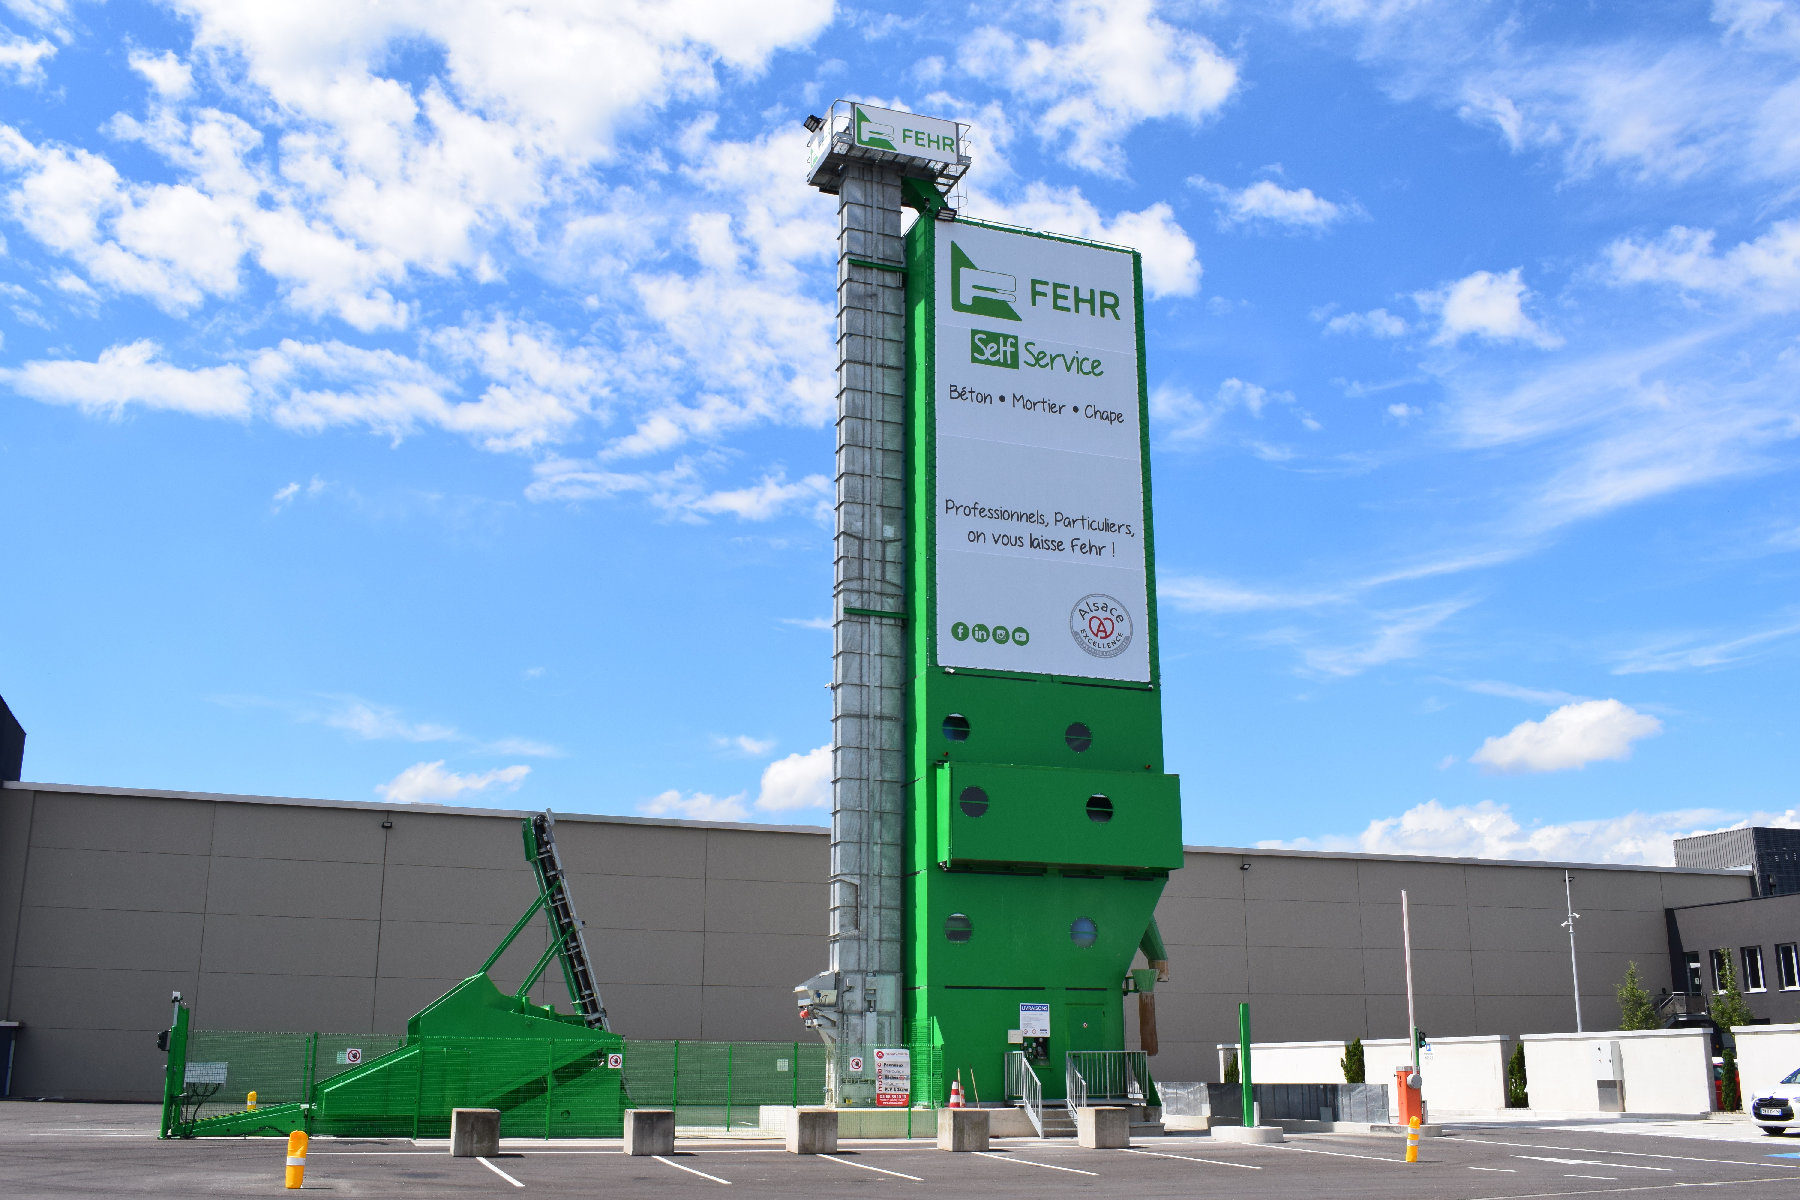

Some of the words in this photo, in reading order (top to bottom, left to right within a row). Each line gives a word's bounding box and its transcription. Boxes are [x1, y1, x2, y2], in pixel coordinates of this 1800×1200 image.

[902, 128, 955, 153] FEHR
[1030, 278, 1121, 321] FEHR
[973, 333, 1016, 365] Self
[1023, 341, 1104, 377] Service
[949, 383, 993, 405] Béton
[1012, 392, 1066, 415] Mortier
[1084, 404, 1125, 425] Chape
[945, 499, 1050, 528] Professionnels,
[1054, 511, 1135, 538] Particuliers,
[967, 530, 986, 543] on
[992, 532, 1024, 548] vous
[1029, 532, 1066, 552] laisse
[1078, 601, 1125, 624] Alsace
[1080, 629, 1124, 649] EXCELLENCE
